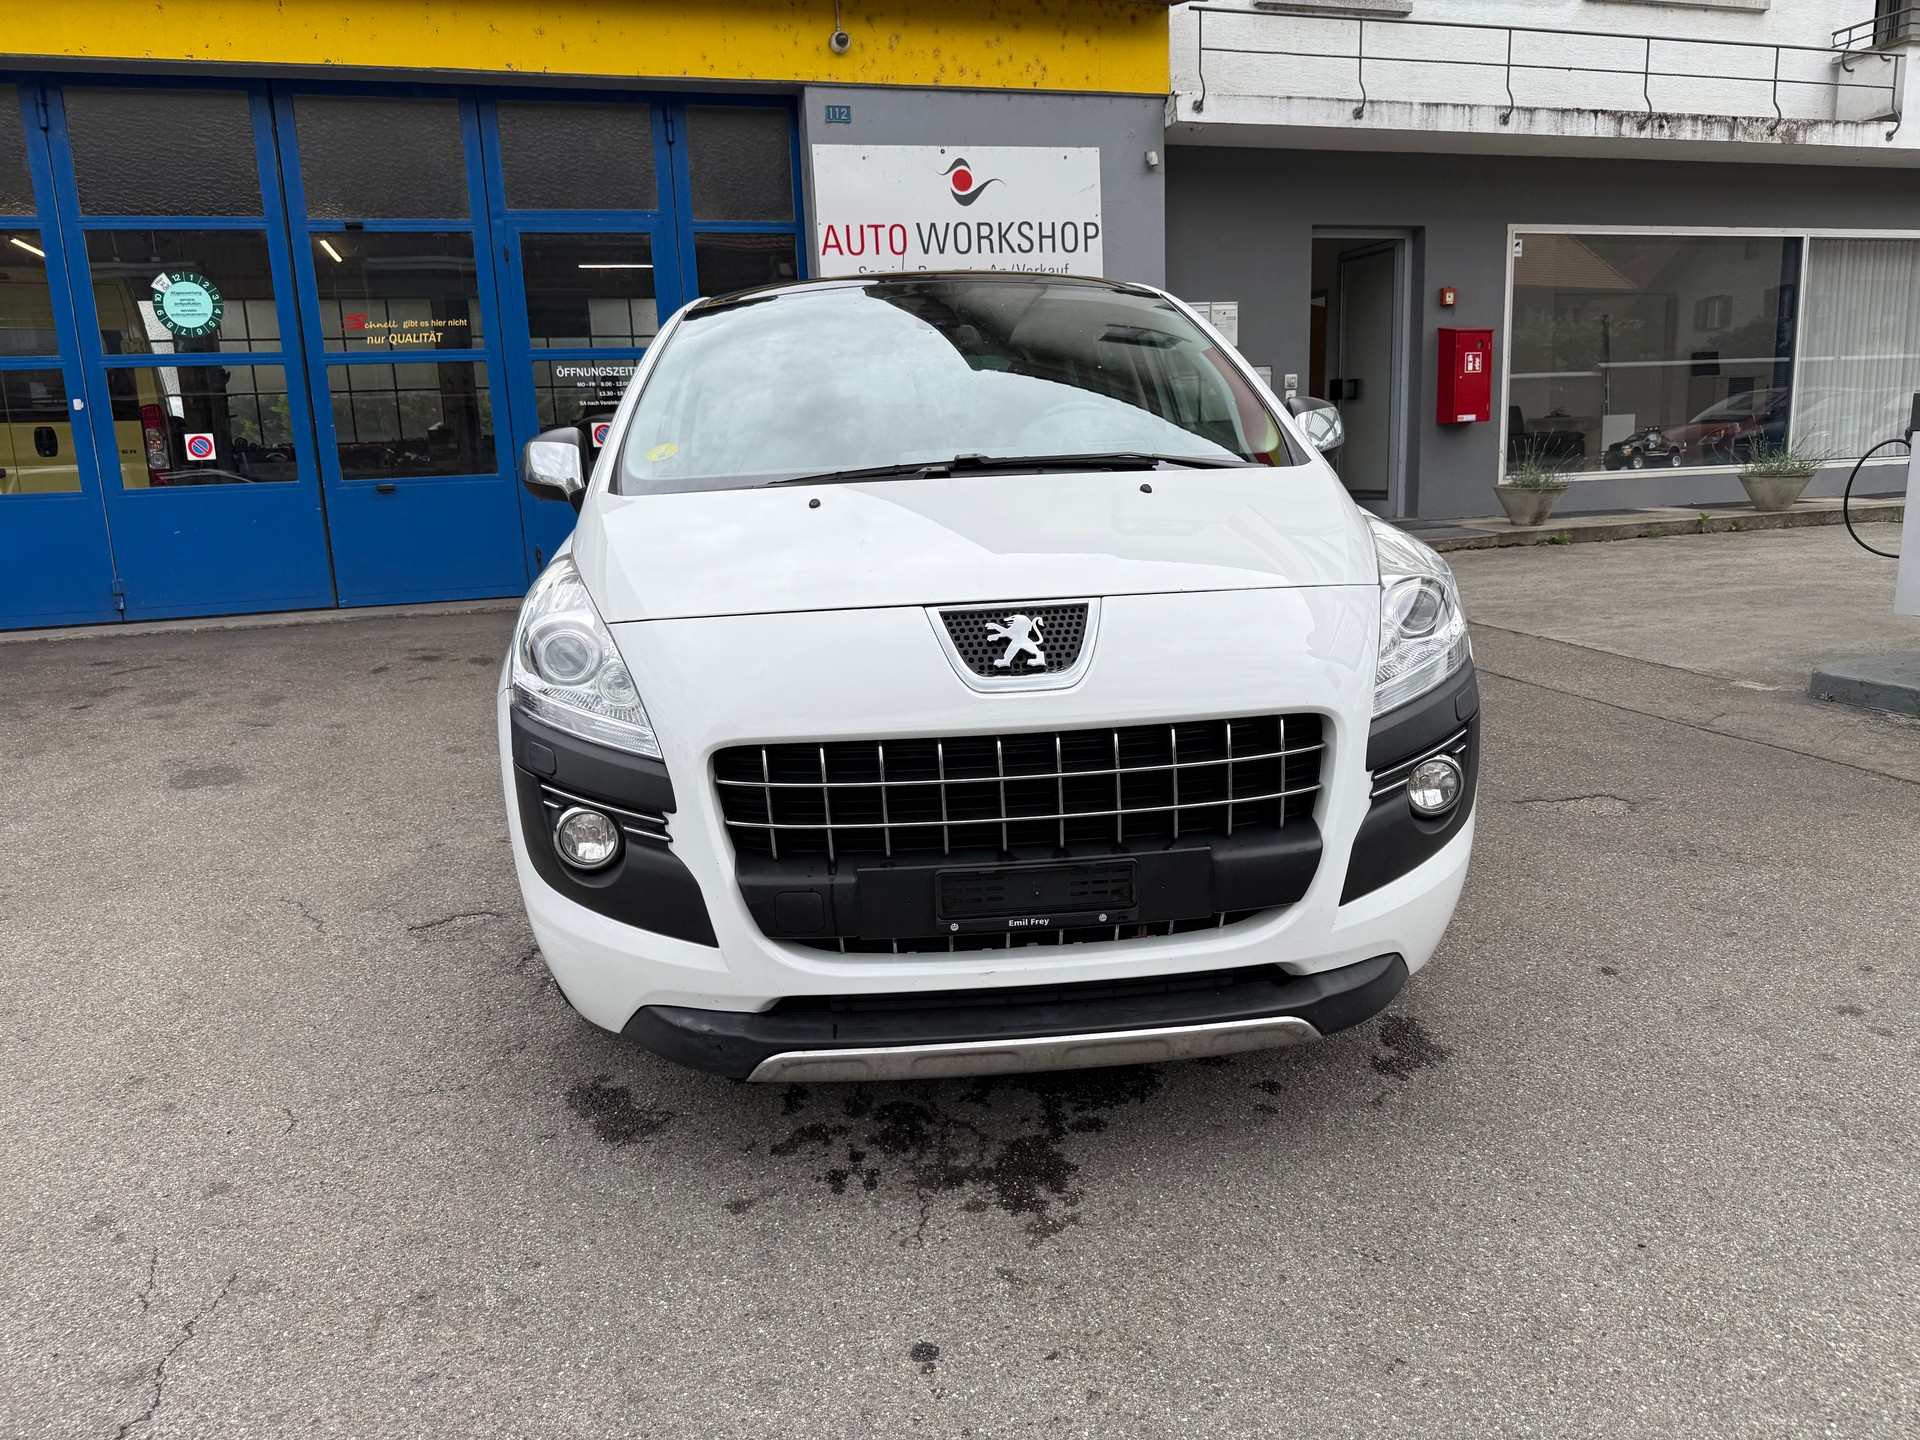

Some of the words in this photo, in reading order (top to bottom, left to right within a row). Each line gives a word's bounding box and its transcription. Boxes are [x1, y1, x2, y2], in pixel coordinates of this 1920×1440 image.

[829, 107, 848, 120] 112
[822, 223, 907, 256] AUTO
[916, 221, 1099, 254] WORKSHOP
[172, 274, 181, 282] 12
[154, 294, 162, 302] 10
[340, 314, 398, 330] Schnell
[402, 320, 418, 328] gibt
[367, 335, 386, 344] nur
[389, 330, 443, 345] QUALITÄT
